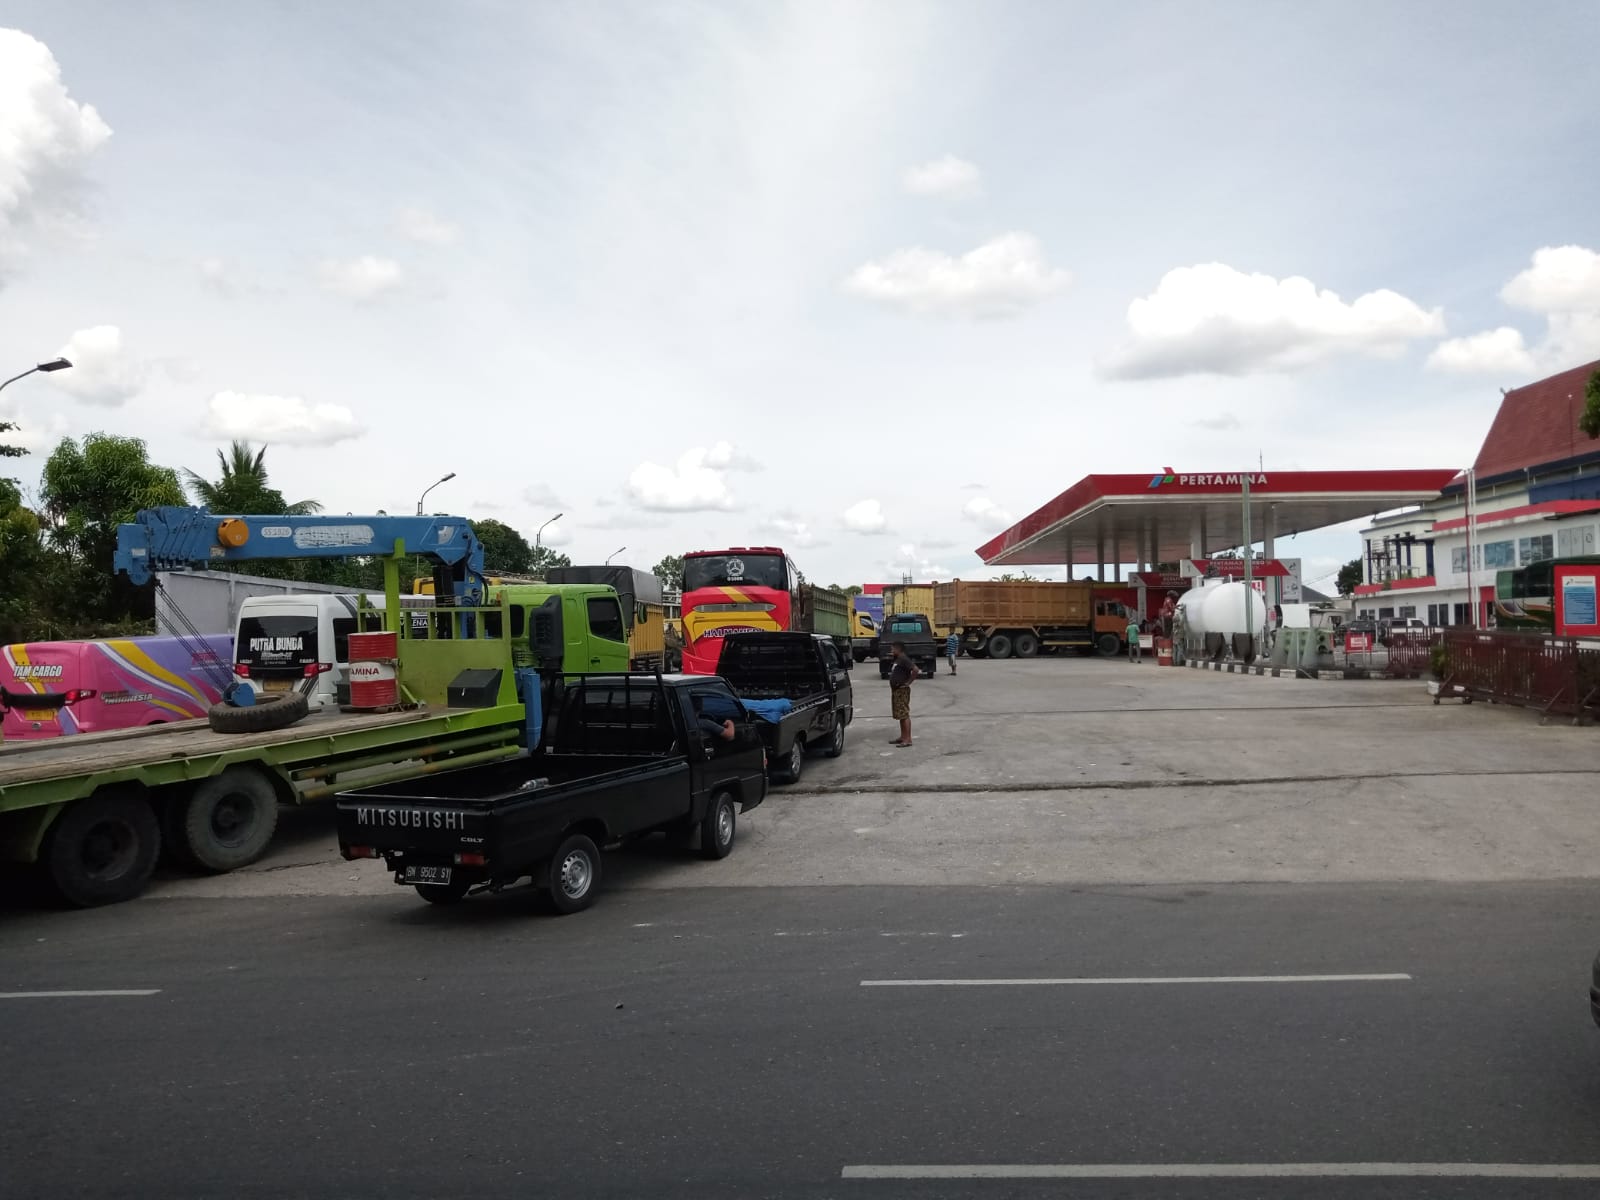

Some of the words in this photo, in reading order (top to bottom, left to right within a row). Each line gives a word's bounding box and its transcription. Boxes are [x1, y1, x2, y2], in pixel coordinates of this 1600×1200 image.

[1180, 474, 1268, 485] PERTAMINA
[250, 637, 274, 652] PUTRA
[275, 637, 304, 651] BUNDA
[14, 665, 32, 677] TAM
[32, 665, 63, 677] CARGO
[357, 807, 464, 830] MITSUBISHI
